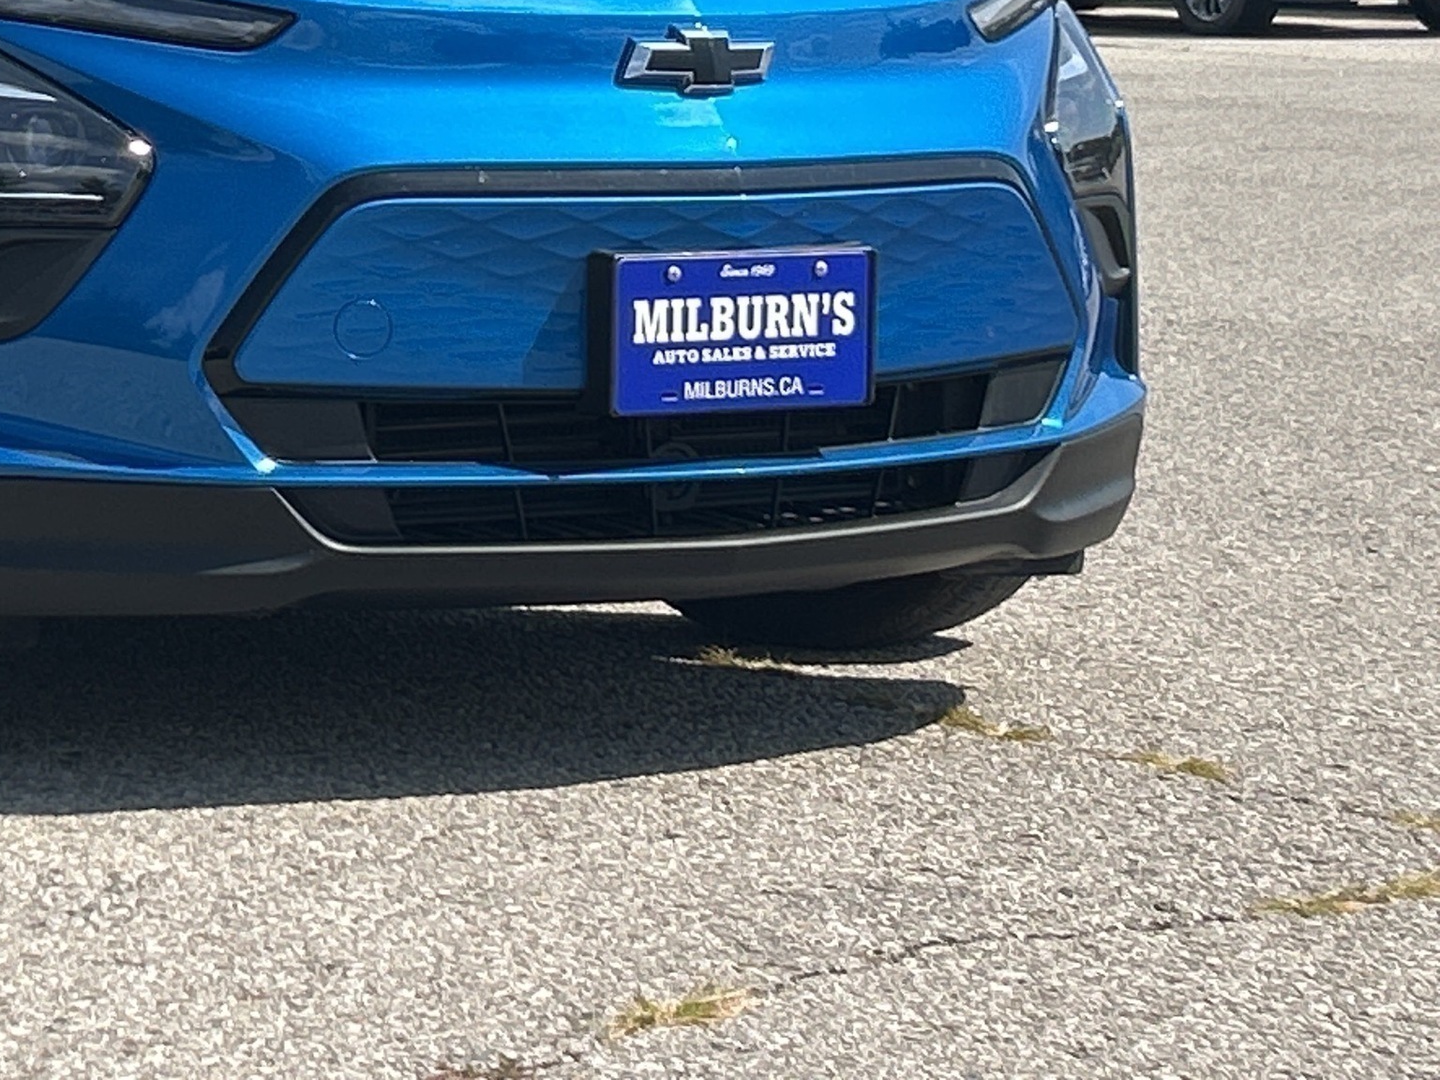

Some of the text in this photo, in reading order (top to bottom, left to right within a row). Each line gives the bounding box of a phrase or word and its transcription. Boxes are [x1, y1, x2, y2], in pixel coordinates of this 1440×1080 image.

[633, 291, 856, 344] MILBURN'S
[653, 342, 836, 365] AUTO SALES & SERVICE
[684, 376, 804, 400] MILBURNS.CA
